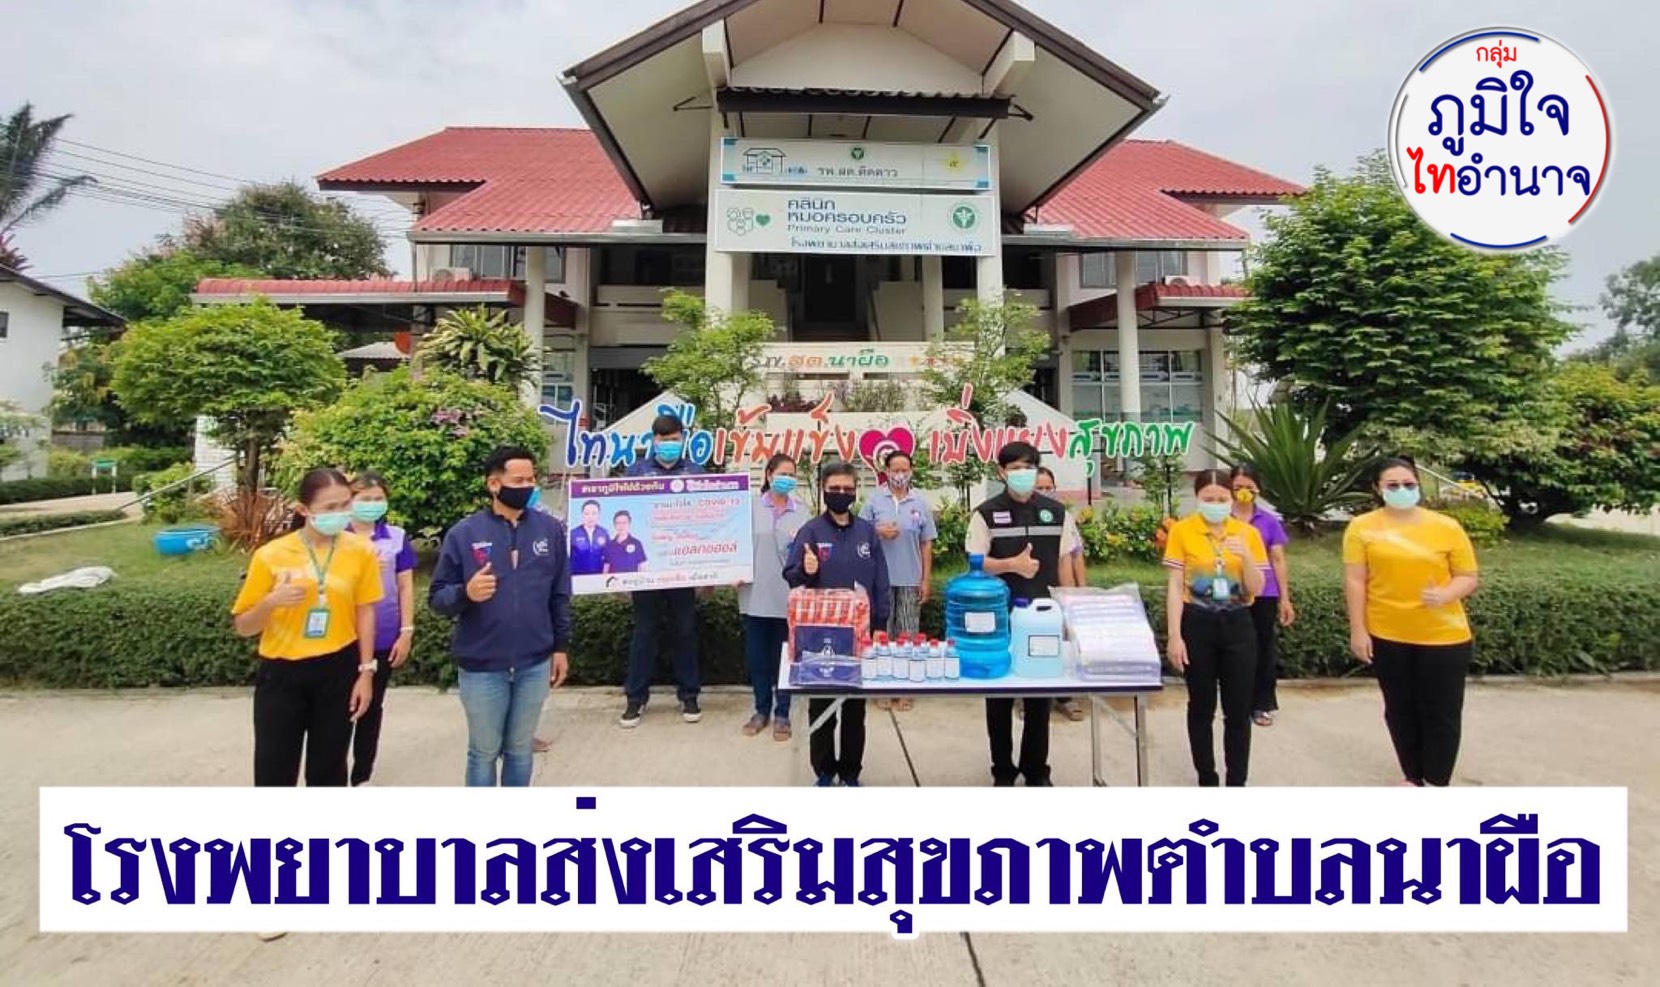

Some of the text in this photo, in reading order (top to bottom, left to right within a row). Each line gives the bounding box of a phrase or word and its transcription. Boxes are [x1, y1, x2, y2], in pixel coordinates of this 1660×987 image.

[787, 198, 836, 211] คลินิก
[787, 210, 907, 225] หมอครอบครัว
[787, 224, 831, 235] Primary
[866, 226, 906, 236] Cluster
